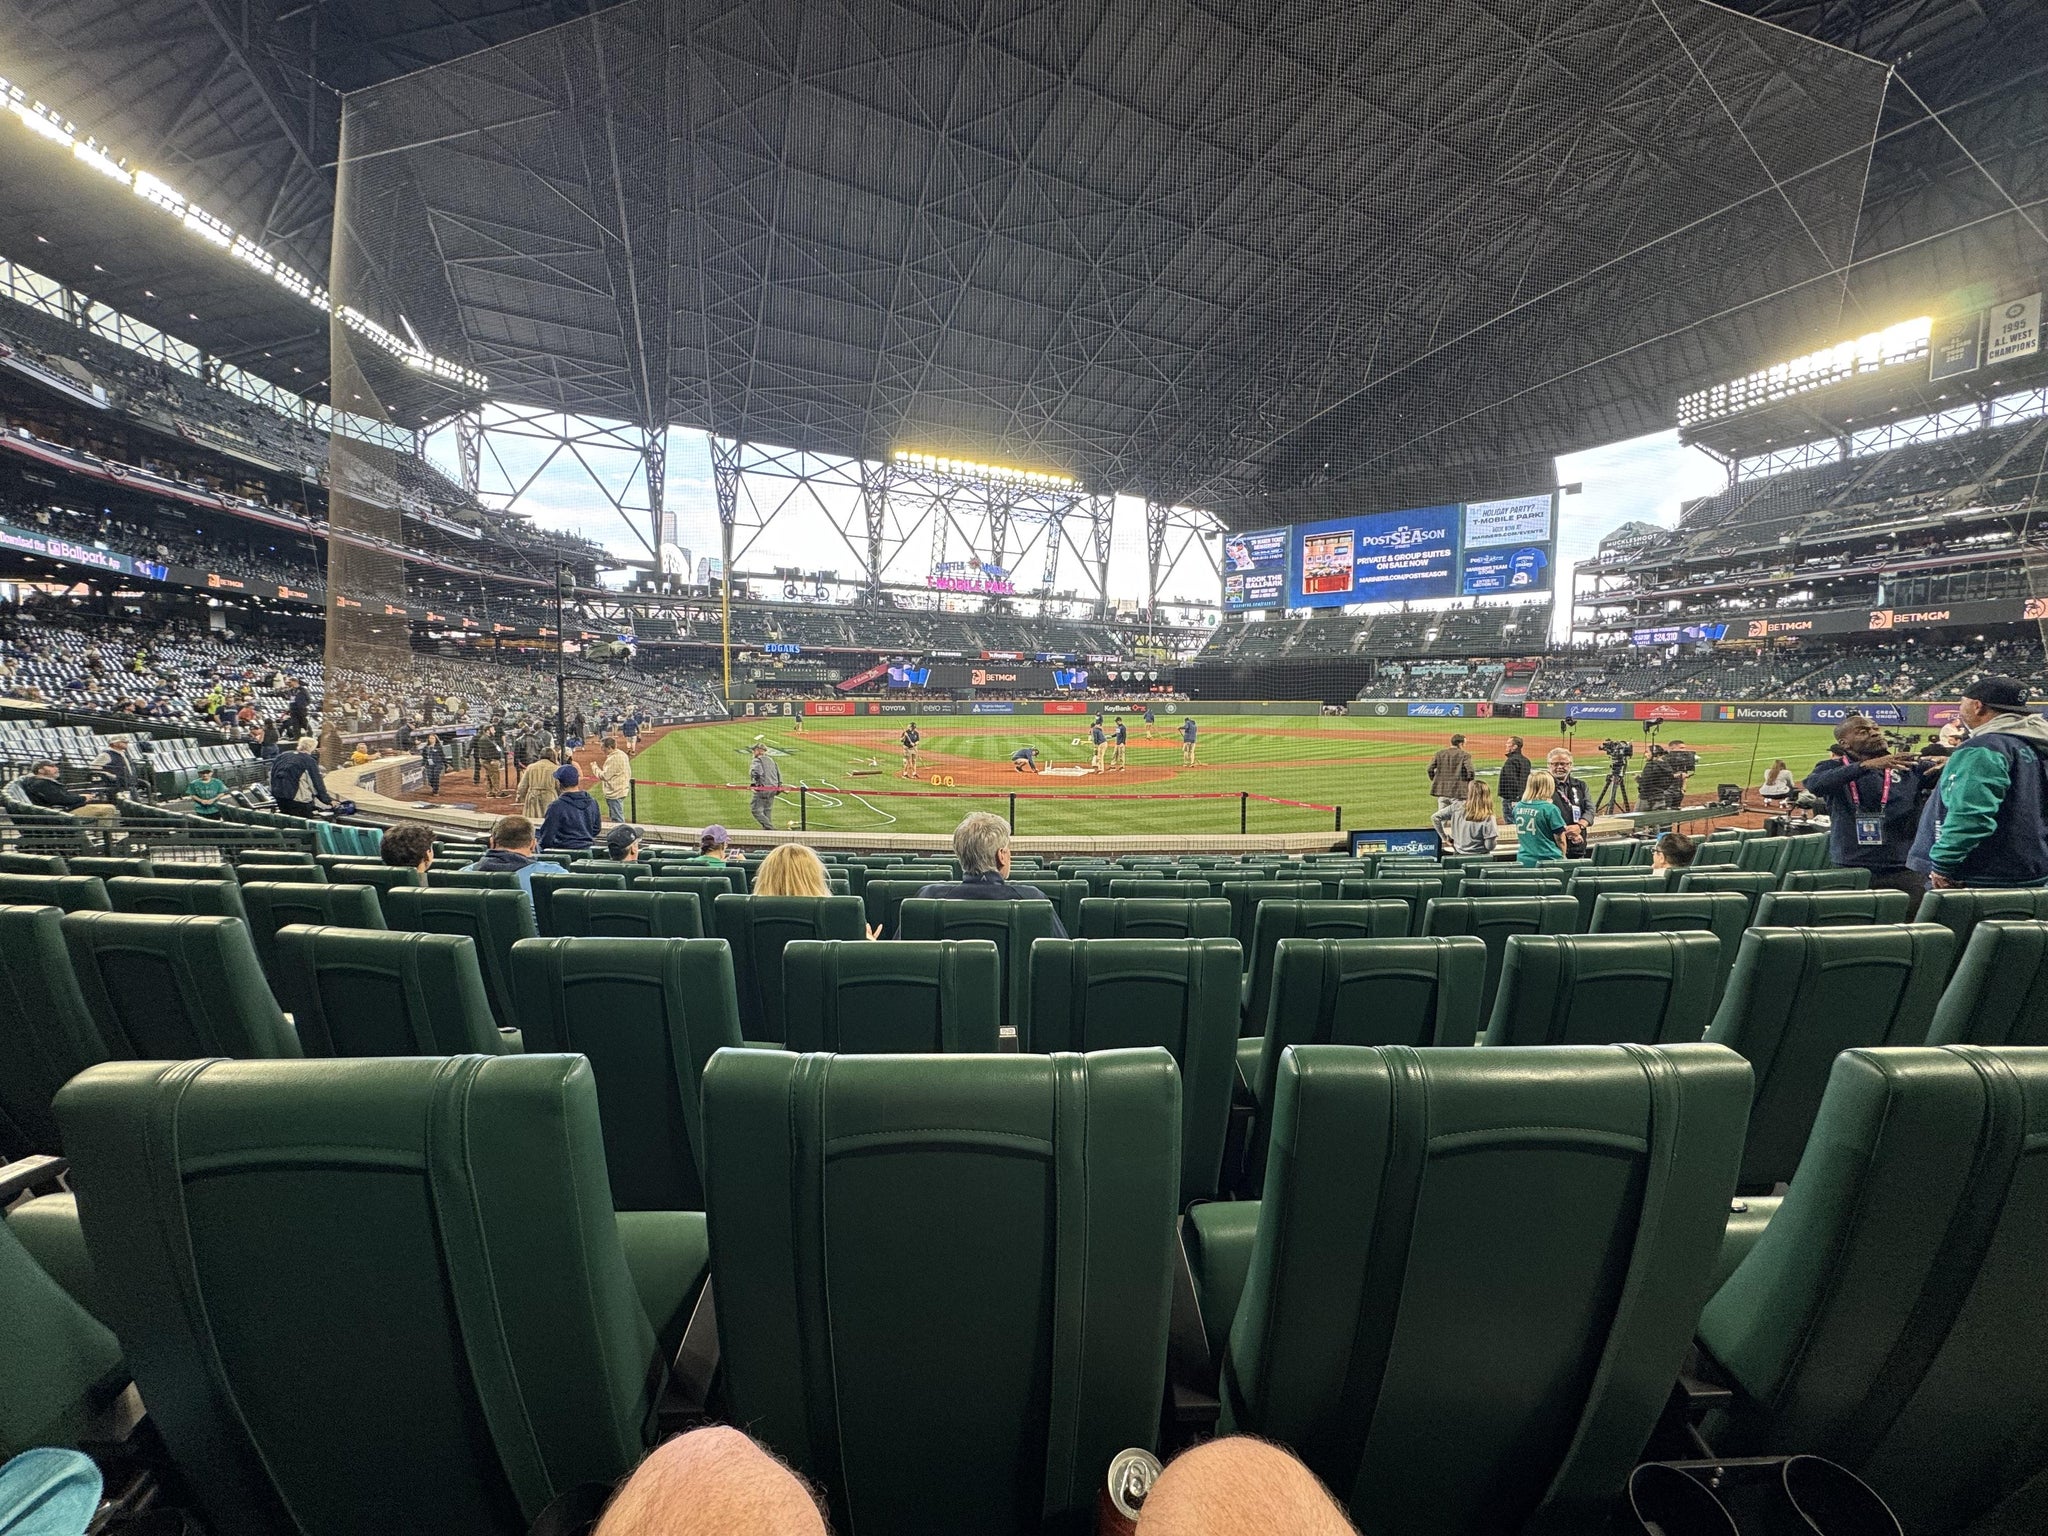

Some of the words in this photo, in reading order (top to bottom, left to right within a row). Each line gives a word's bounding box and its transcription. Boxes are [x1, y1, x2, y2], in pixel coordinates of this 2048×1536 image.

[2002, 319, 2026, 334] 1995
[1994, 337, 2009, 347] A.L.
[2009, 329, 2033, 343] WEST
[1988, 339, 2037, 360] CHAMPIONS
[1482, 507, 1509, 517] HOLIDAY
[1509, 504, 1536, 514] PARTY?
[1473, 515, 1514, 525] T-MOBILE
[1516, 511, 1544, 520] PARK!
[1362, 529, 1445, 547] POSTSEASON
[1357, 555, 1387, 565] PRIVATE
[1387, 554, 1394, 562] &
[1394, 552, 1421, 561] GROUP
[1422, 549, 1451, 558] SUITES
[1389, 561, 1409, 569] SALE
[1409, 559, 1429, 567] NOW
[1359, 570, 1447, 583] MARINERS.COM/POSTSEASON
[926, 576, 982, 592] T-MOBILE
[984, 580, 1016, 595] PARK
[1245, 580, 1283, 589] BALLPARK
[1894, 610, 1950, 624] BETMGM
[1767, 621, 1812, 632] BETMGM
[764, 643, 800, 653] EDGARS
[986, 673, 1017, 682] BETMGM
[1104, 704, 1132, 713] KeyBank
[1410, 704, 1445, 715] Alaska
[1737, 707, 1788, 719] Microsoft
[1817, 709, 1873, 719] GLOL
[1516, 816, 1537, 835] 24
[1391, 843, 1435, 853] POSTSEASON
